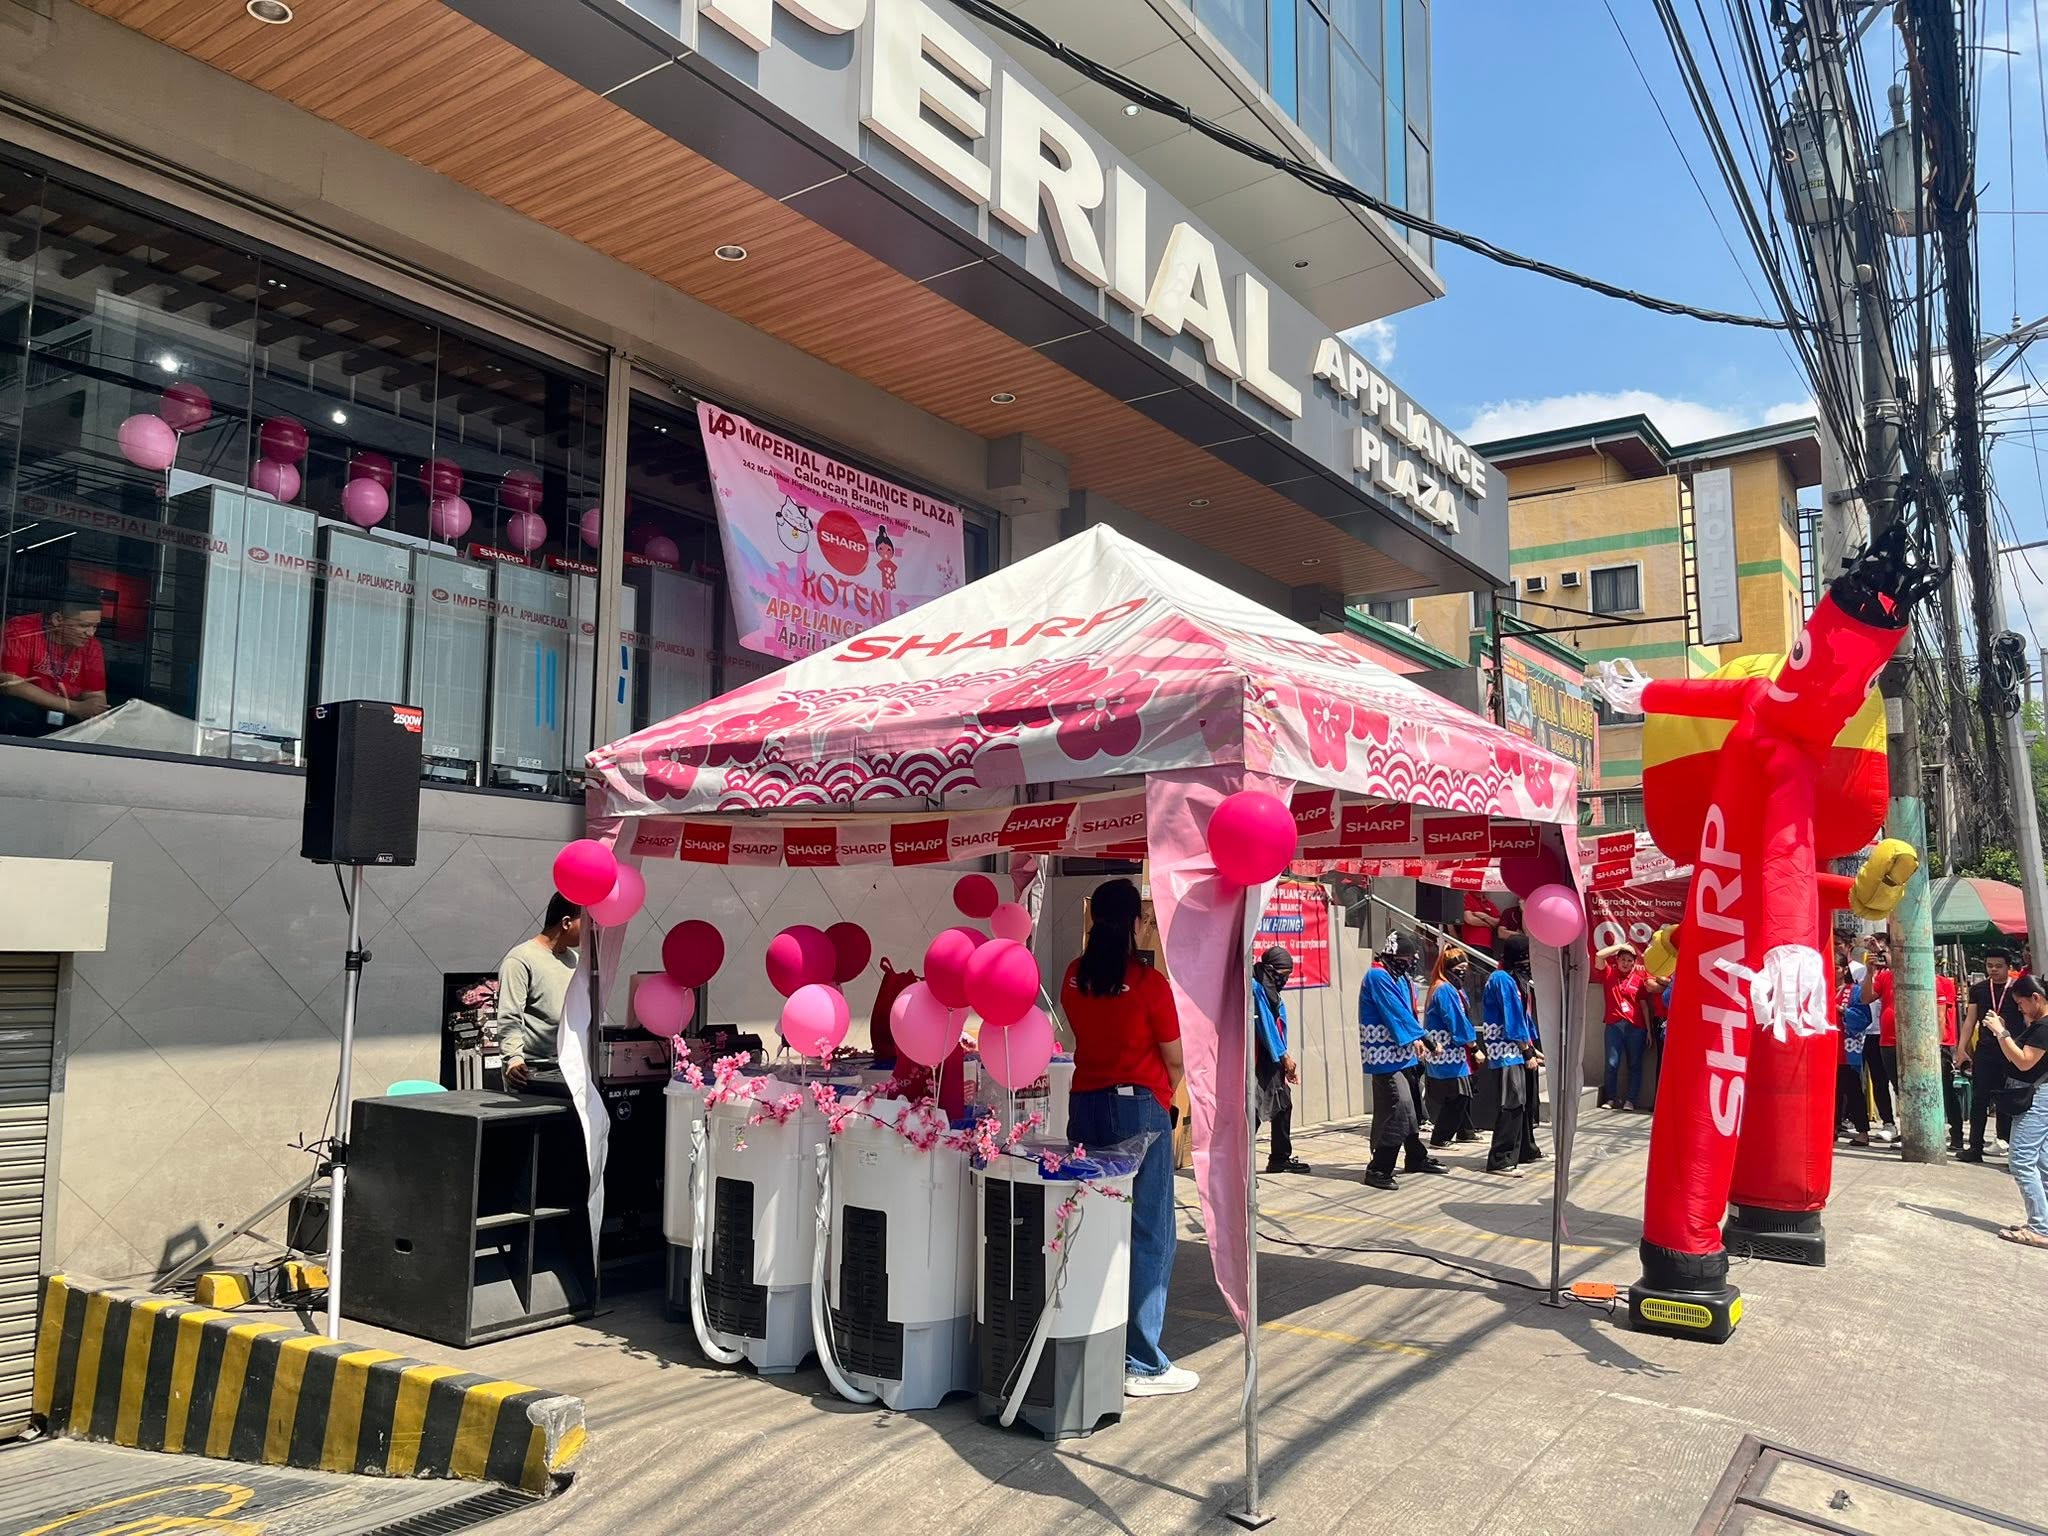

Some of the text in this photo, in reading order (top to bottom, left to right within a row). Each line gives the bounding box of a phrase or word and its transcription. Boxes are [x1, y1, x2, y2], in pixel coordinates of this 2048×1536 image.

[1313, 337, 1486, 498] APPLIANCE
[740, 425, 820, 472] IMPERIAL
[826, 462, 908, 508] APPLIANCE
[913, 497, 955, 527] PLAZA
[1353, 427, 1460, 534] PLAZA
[794, 467, 889, 513] Caloocan Branch
[742, 459, 756, 470] 242
[757, 464, 790, 483] McArthur
[851, 502, 880, 519] Caloocan
[880, 514, 894, 525] City,
[894, 519, 912, 530] Metro
[912, 526, 930, 538] Manila
[54, 502, 229, 554] IMPERIAL APPLIANCE PLAZA
[821, 530, 866, 552] SHARP
[480, 548, 524, 564] SHARP
[632, 556, 672, 569] SHARP
[555, 558, 598, 574] SHARP
[274, 552, 354, 583] IMPERIAL
[356, 572, 394, 591] APPLIANCE
[395, 581, 416, 596] PLAZA
[801, 567, 886, 619] KOTEN
[452, 593, 518, 618] IMPERIAL
[520, 609, 551, 626] APPLIANCE
[551, 616, 568, 630] PLAZA
[832, 597, 1150, 662] SHARP
[778, 626, 816, 652] April
[655, 641, 680, 656] APPLIANCE
[1528, 676, 1593, 740] FULL HOUSE
[394, 713, 422, 726] 2500W
[1550, 728, 1574, 758] DISCO
[1006, 816, 1064, 831] SHARP
[1082, 813, 1144, 832] SHARP
[1346, 820, 1405, 832] SHARP
[636, 835, 674, 848] SHARP
[952, 831, 999, 847] SHARP
[1428, 830, 1484, 844] SHARP
[684, 839, 726, 852] SHARP
[732, 843, 778, 855] SHARP
[787, 844, 832, 855] SHARP
[840, 843, 886, 856] SHARP
[894, 838, 943, 853] SHARP
[1600, 844, 1633, 854] SHARP
[1635, 858, 1669, 871] SHARP
[1452, 877, 1480, 886] SHARP
[1596, 868, 1629, 880] SHARP
[1592, 898, 1630, 907] Upgrade
[1656, 898, 1682, 906] home
[1626, 909, 1642, 917] low
[1272, 918, 1304, 931] HIRING!
[1696, 803, 1747, 1137] SHARP
